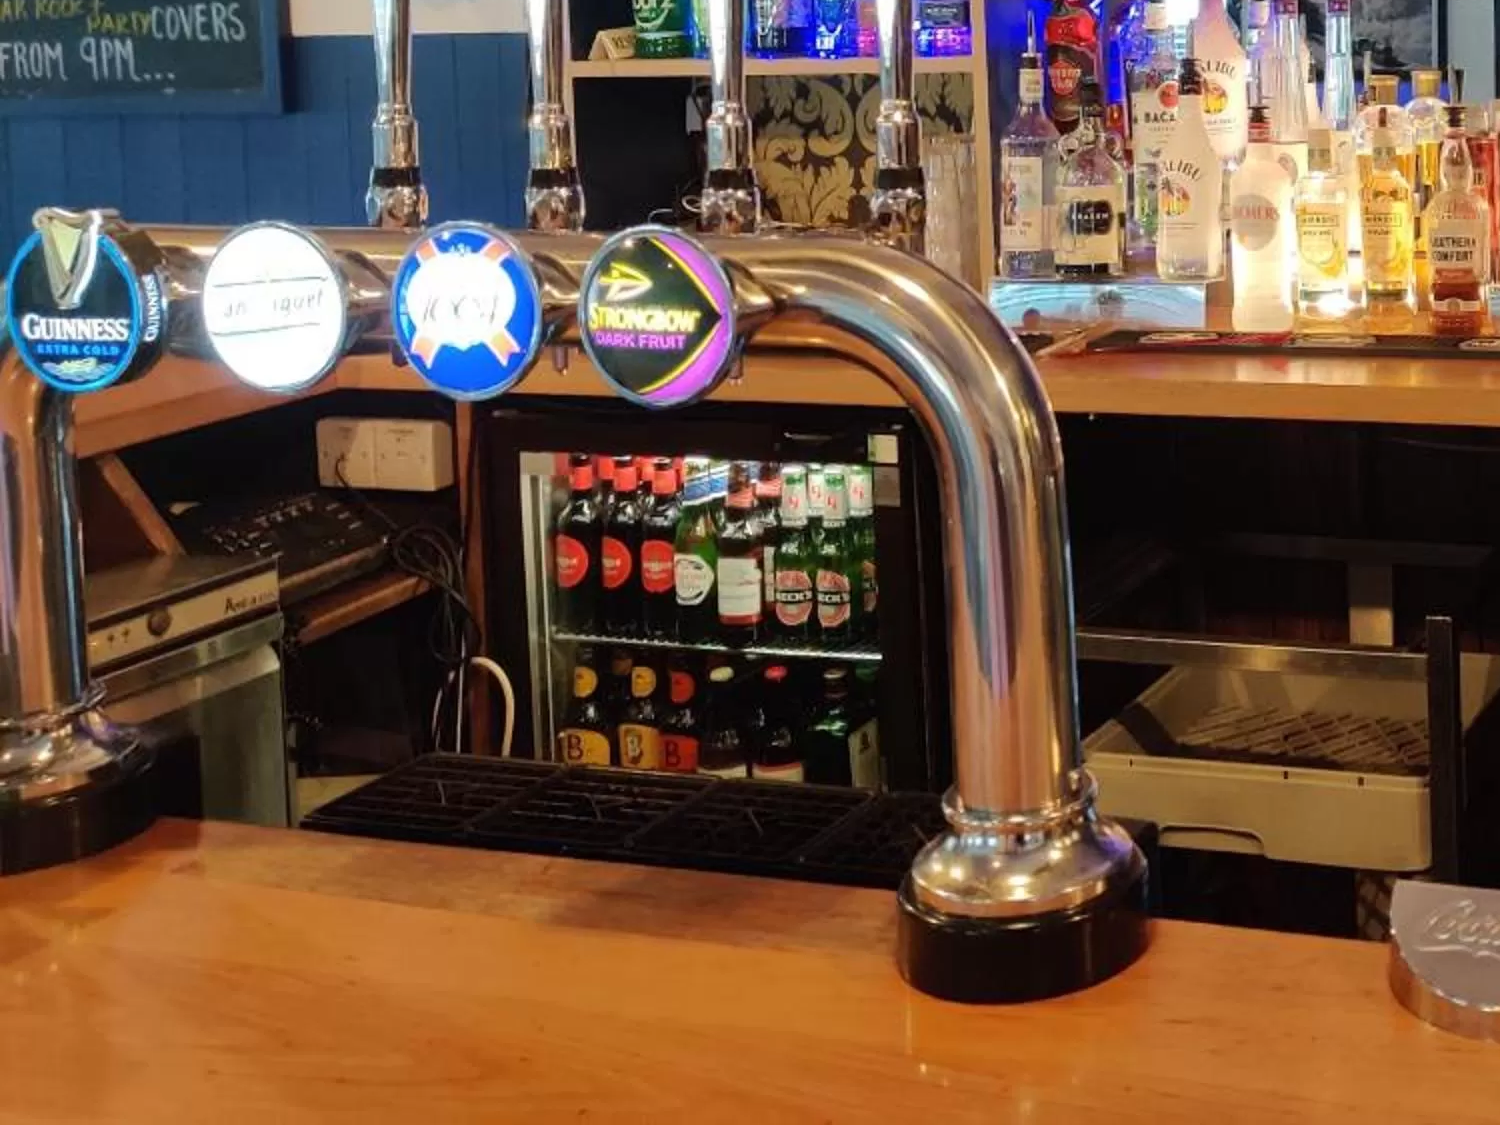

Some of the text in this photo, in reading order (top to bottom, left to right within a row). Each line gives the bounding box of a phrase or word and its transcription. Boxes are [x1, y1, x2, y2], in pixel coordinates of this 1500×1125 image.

[151, 2, 246, 43] COVERS
[0, 41, 68, 81] FROM
[22, 314, 130, 342] GUINNESS
[594, 333, 686, 350] DARK FRUIT
[83, 344, 119, 355] COLD
